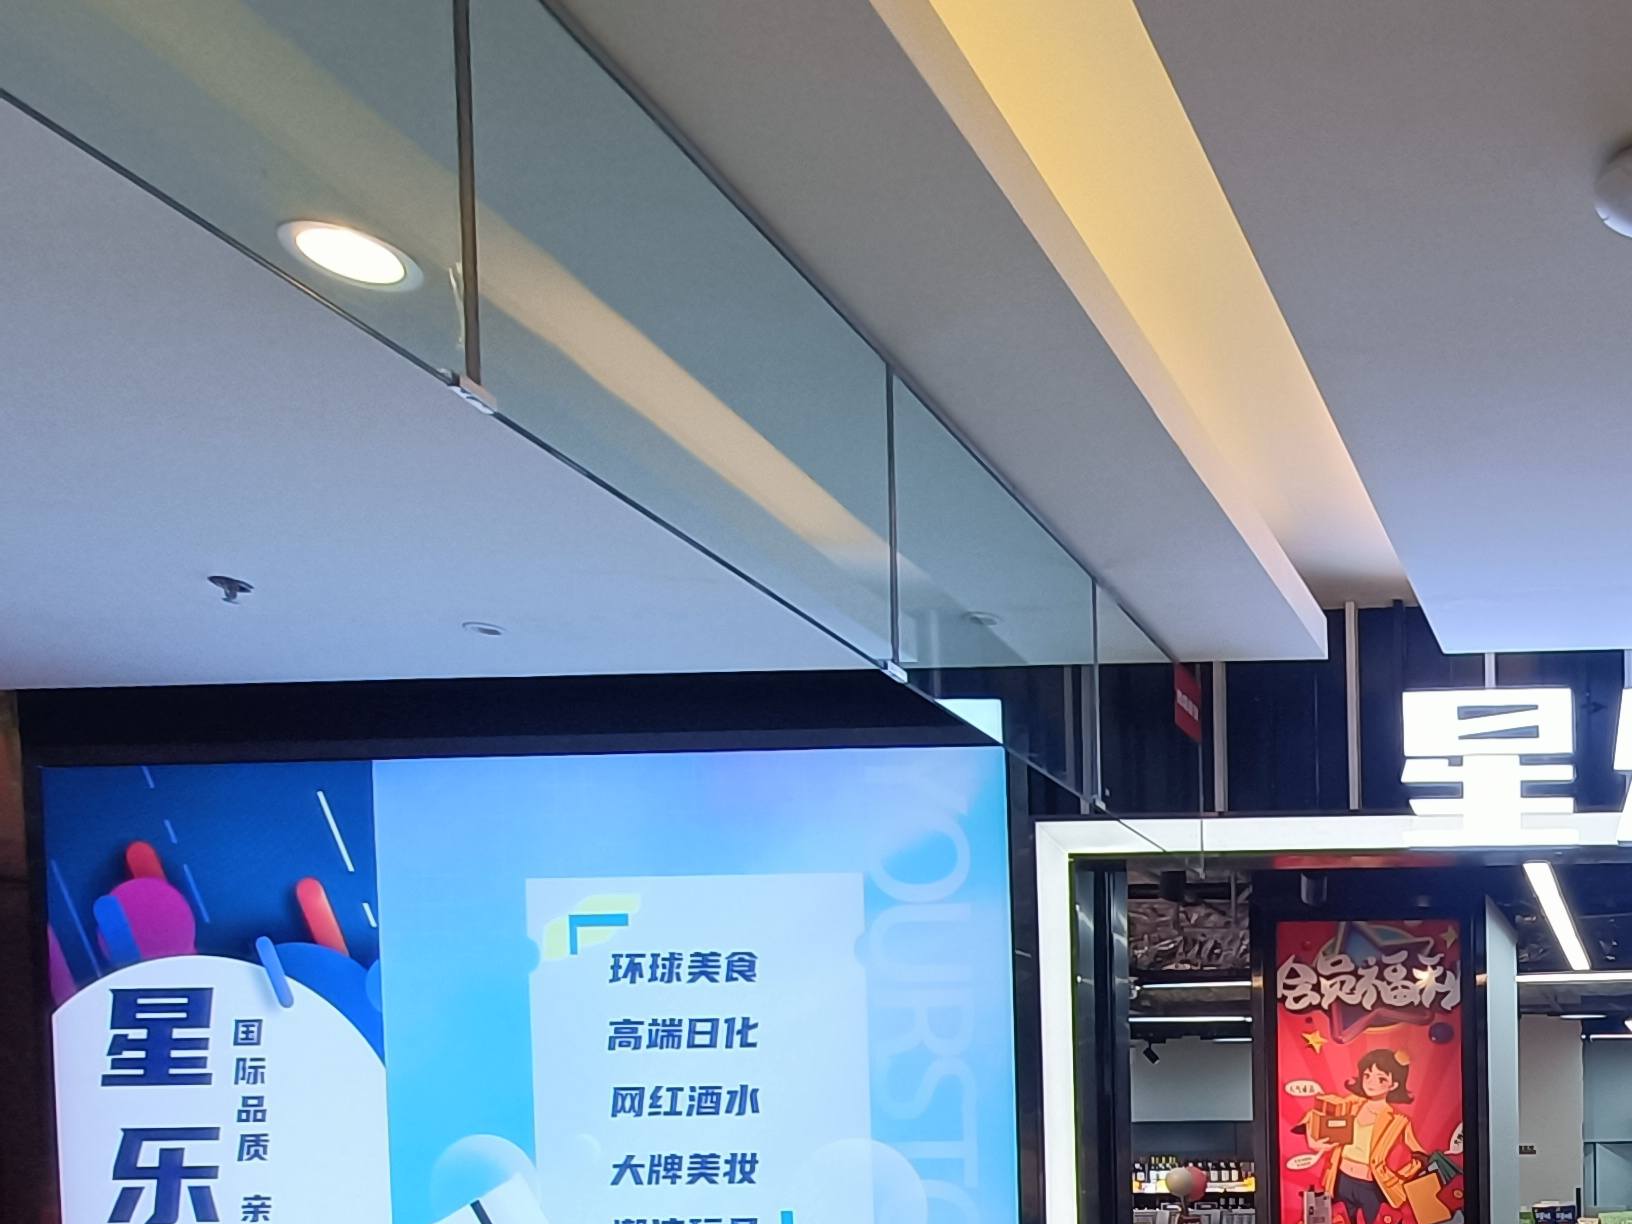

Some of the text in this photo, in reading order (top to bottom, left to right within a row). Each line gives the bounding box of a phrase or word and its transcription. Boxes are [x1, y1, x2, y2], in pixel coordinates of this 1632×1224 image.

[608, 951, 758, 985] 环球美食
[607, 1017, 759, 1051] 高端日化
[233, 1018, 269, 1163] 国际品质
[611, 1085, 761, 1119] 网红酒水
[610, 1153, 759, 1186] 大牌美妆
